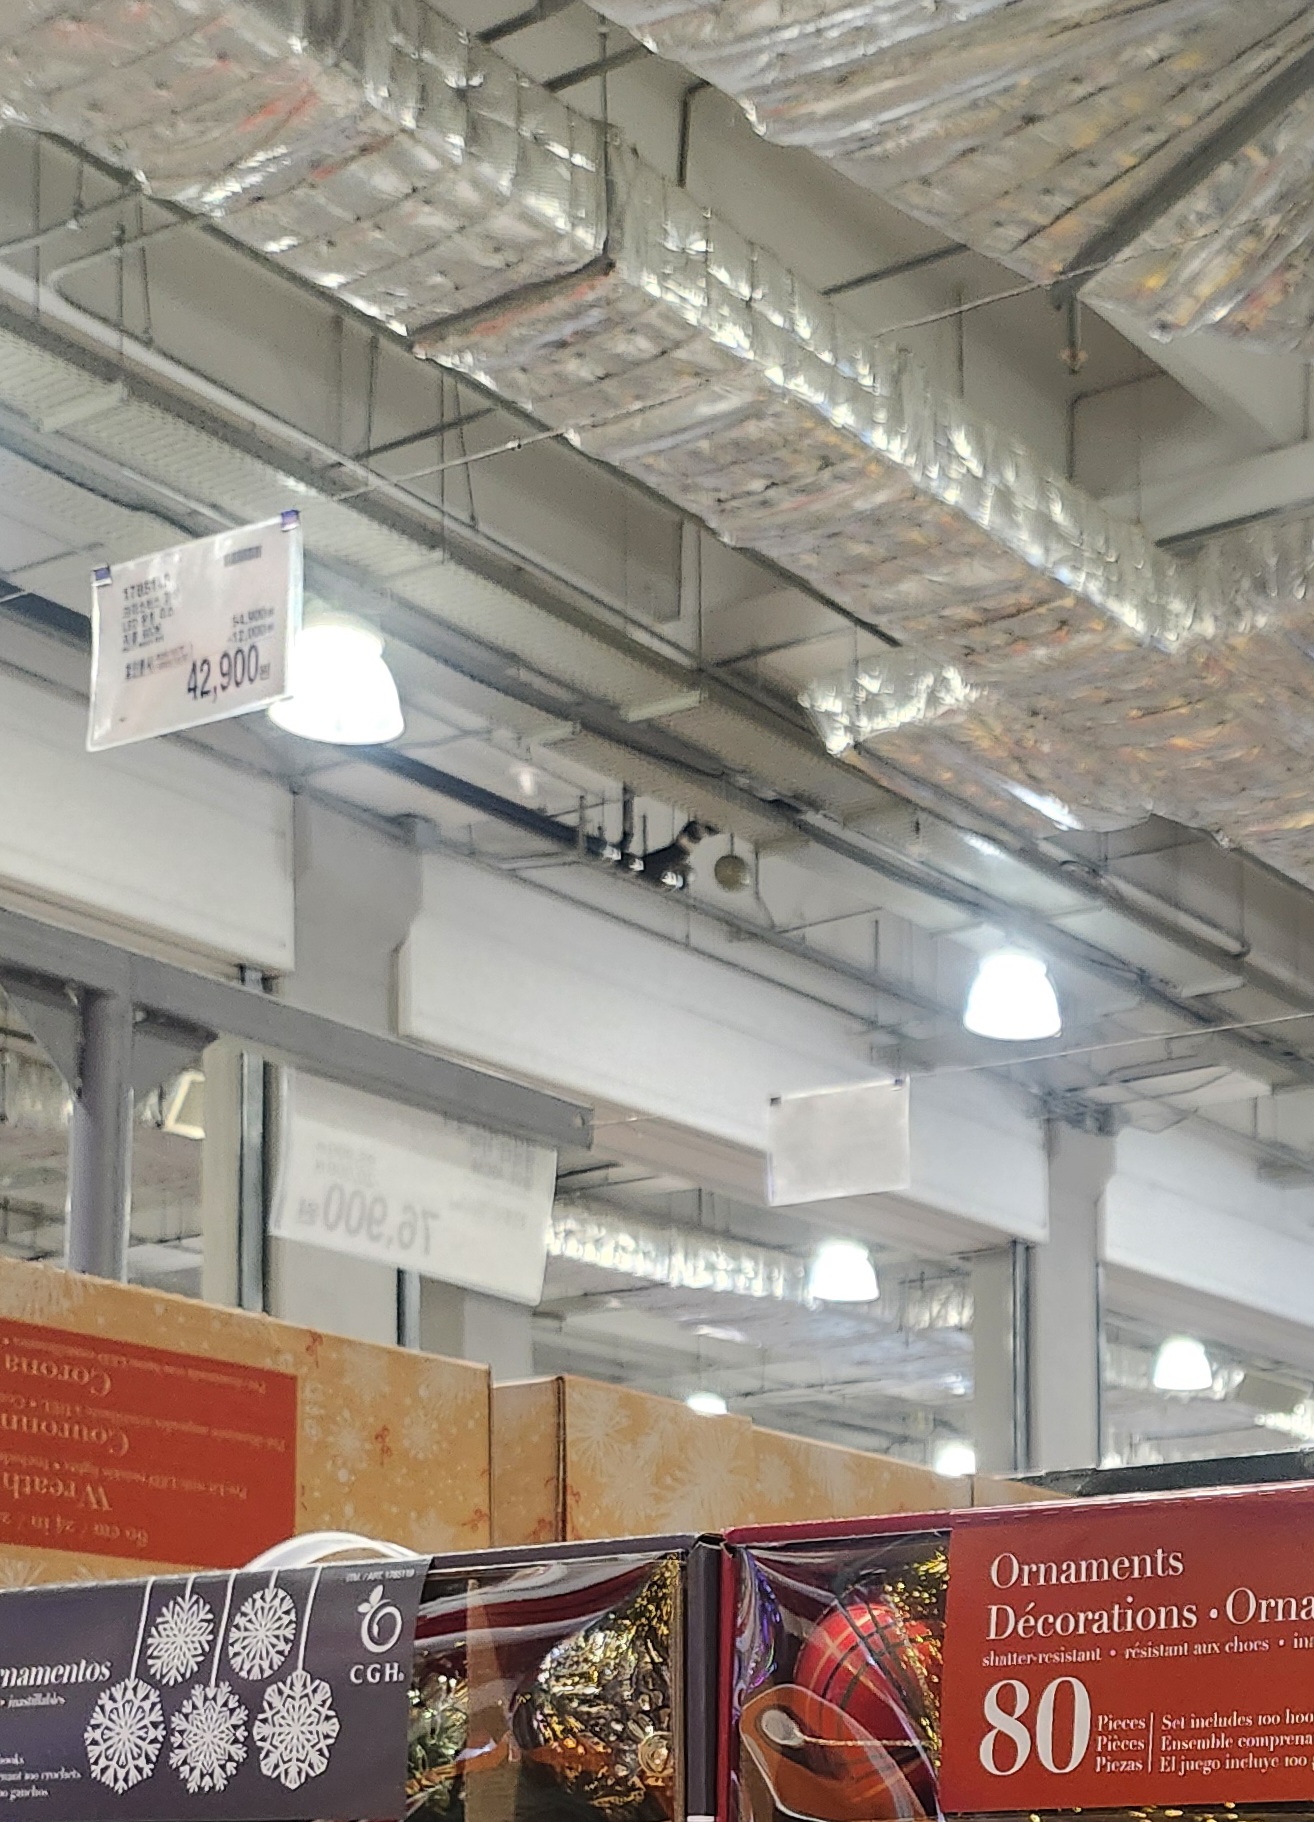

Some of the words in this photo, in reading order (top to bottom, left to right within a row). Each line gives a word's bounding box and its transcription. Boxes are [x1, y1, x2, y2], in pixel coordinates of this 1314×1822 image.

[5, 1353, 112, 1397] Corona
[3, 1471, 112, 1511] Wreath
[990, 1548, 1184, 1589] Ornaments
[986, 1595, 1198, 1641] Décorations
[982, 1646, 1102, 1668] shatter-resistant
[1124, 1637, 1189, 1661] résistant
[1193, 1640, 1220, 1656] aux
[1224, 1634, 1270, 1654] chocs
[979, 1676, 1091, 1776] 80
[1097, 1713, 1146, 1733] Pieces
[1161, 1713, 1185, 1731] Set
[1190, 1710, 1253, 1731] includes
[1257, 1713, 1281, 1727] 100
[1096, 1733, 1145, 1753] Pièces
[1160, 1731, 1234, 1752] Ensemble
[1095, 1755, 1143, 1774] Piezas
[1159, 1754, 1175, 1773] El
[1177, 1753, 1221, 1776] juego
[1224, 1750, 1280, 1775] incluye
[1283, 1751, 1307, 1767] 100
